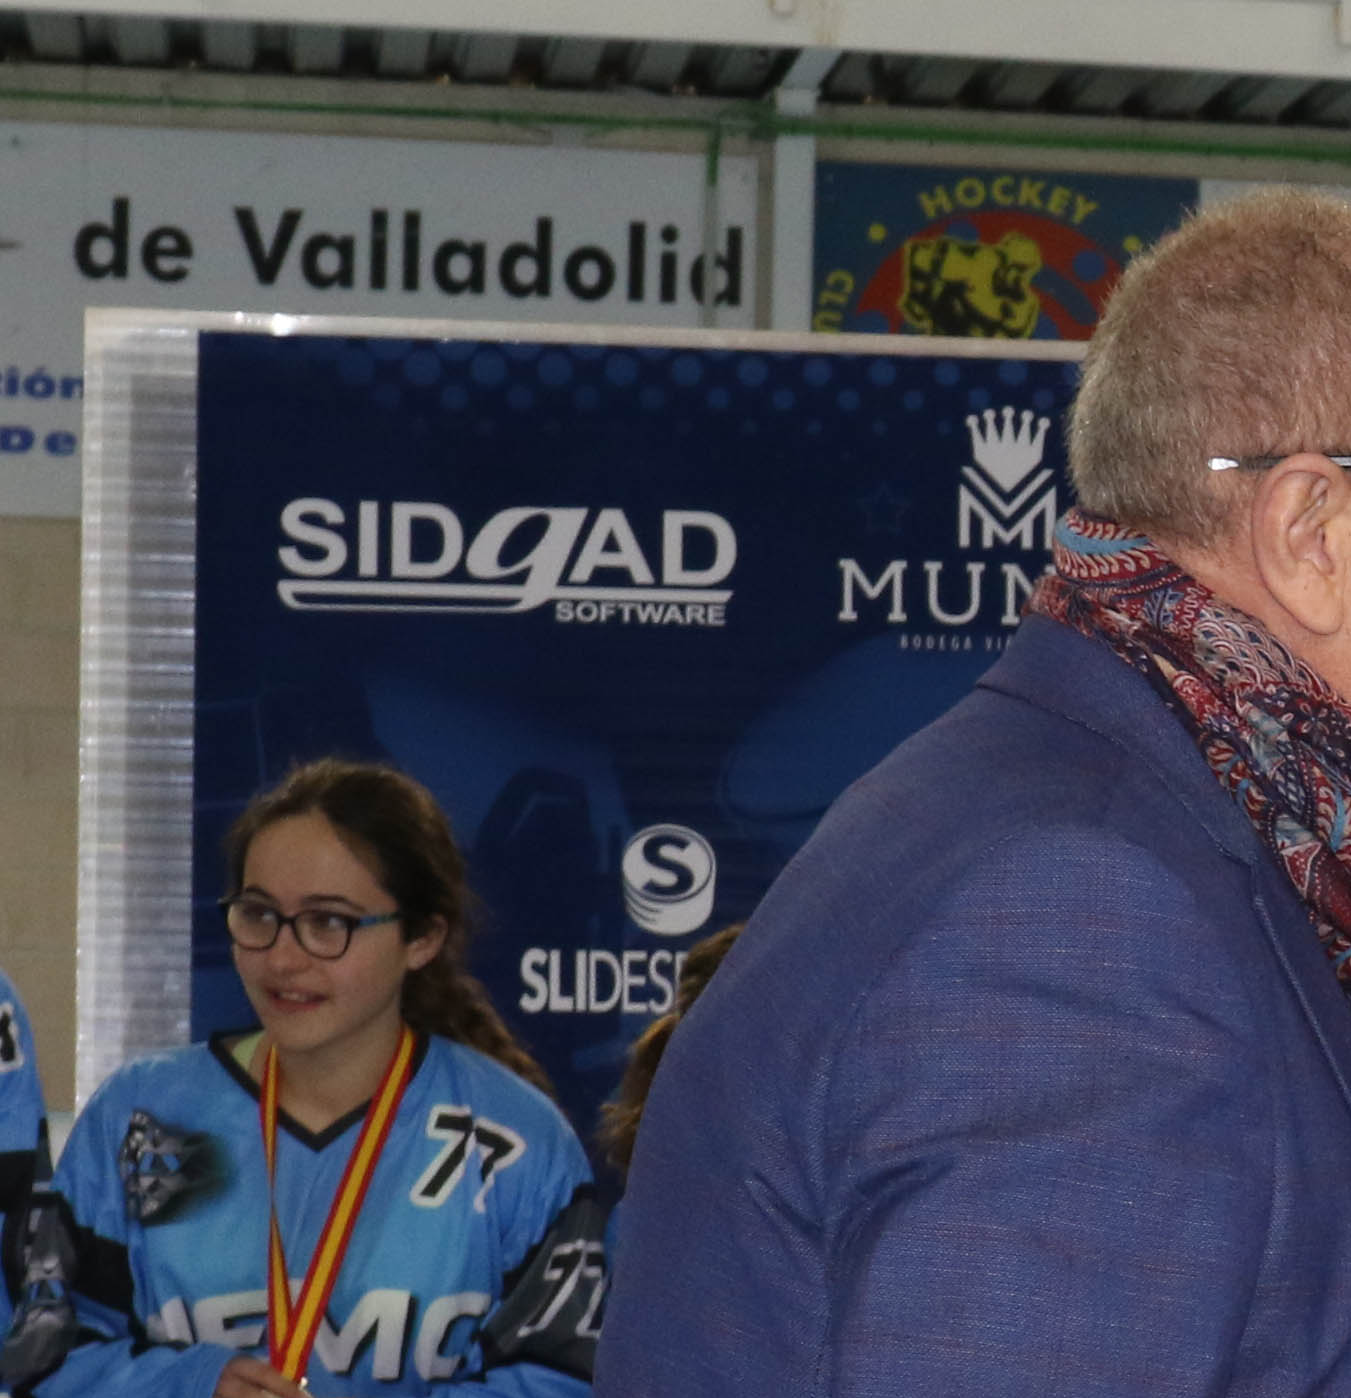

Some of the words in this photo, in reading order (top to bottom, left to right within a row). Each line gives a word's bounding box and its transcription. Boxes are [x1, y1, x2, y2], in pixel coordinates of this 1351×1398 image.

[918, 175, 1098, 225] HOCKEY
[74, 197, 194, 283] de
[234, 204, 743, 309] Valladolid
[554, 600, 727, 627] SOFTWARE
[900, 634, 973, 651] BODEGA
[410, 1104, 526, 1214] 77
